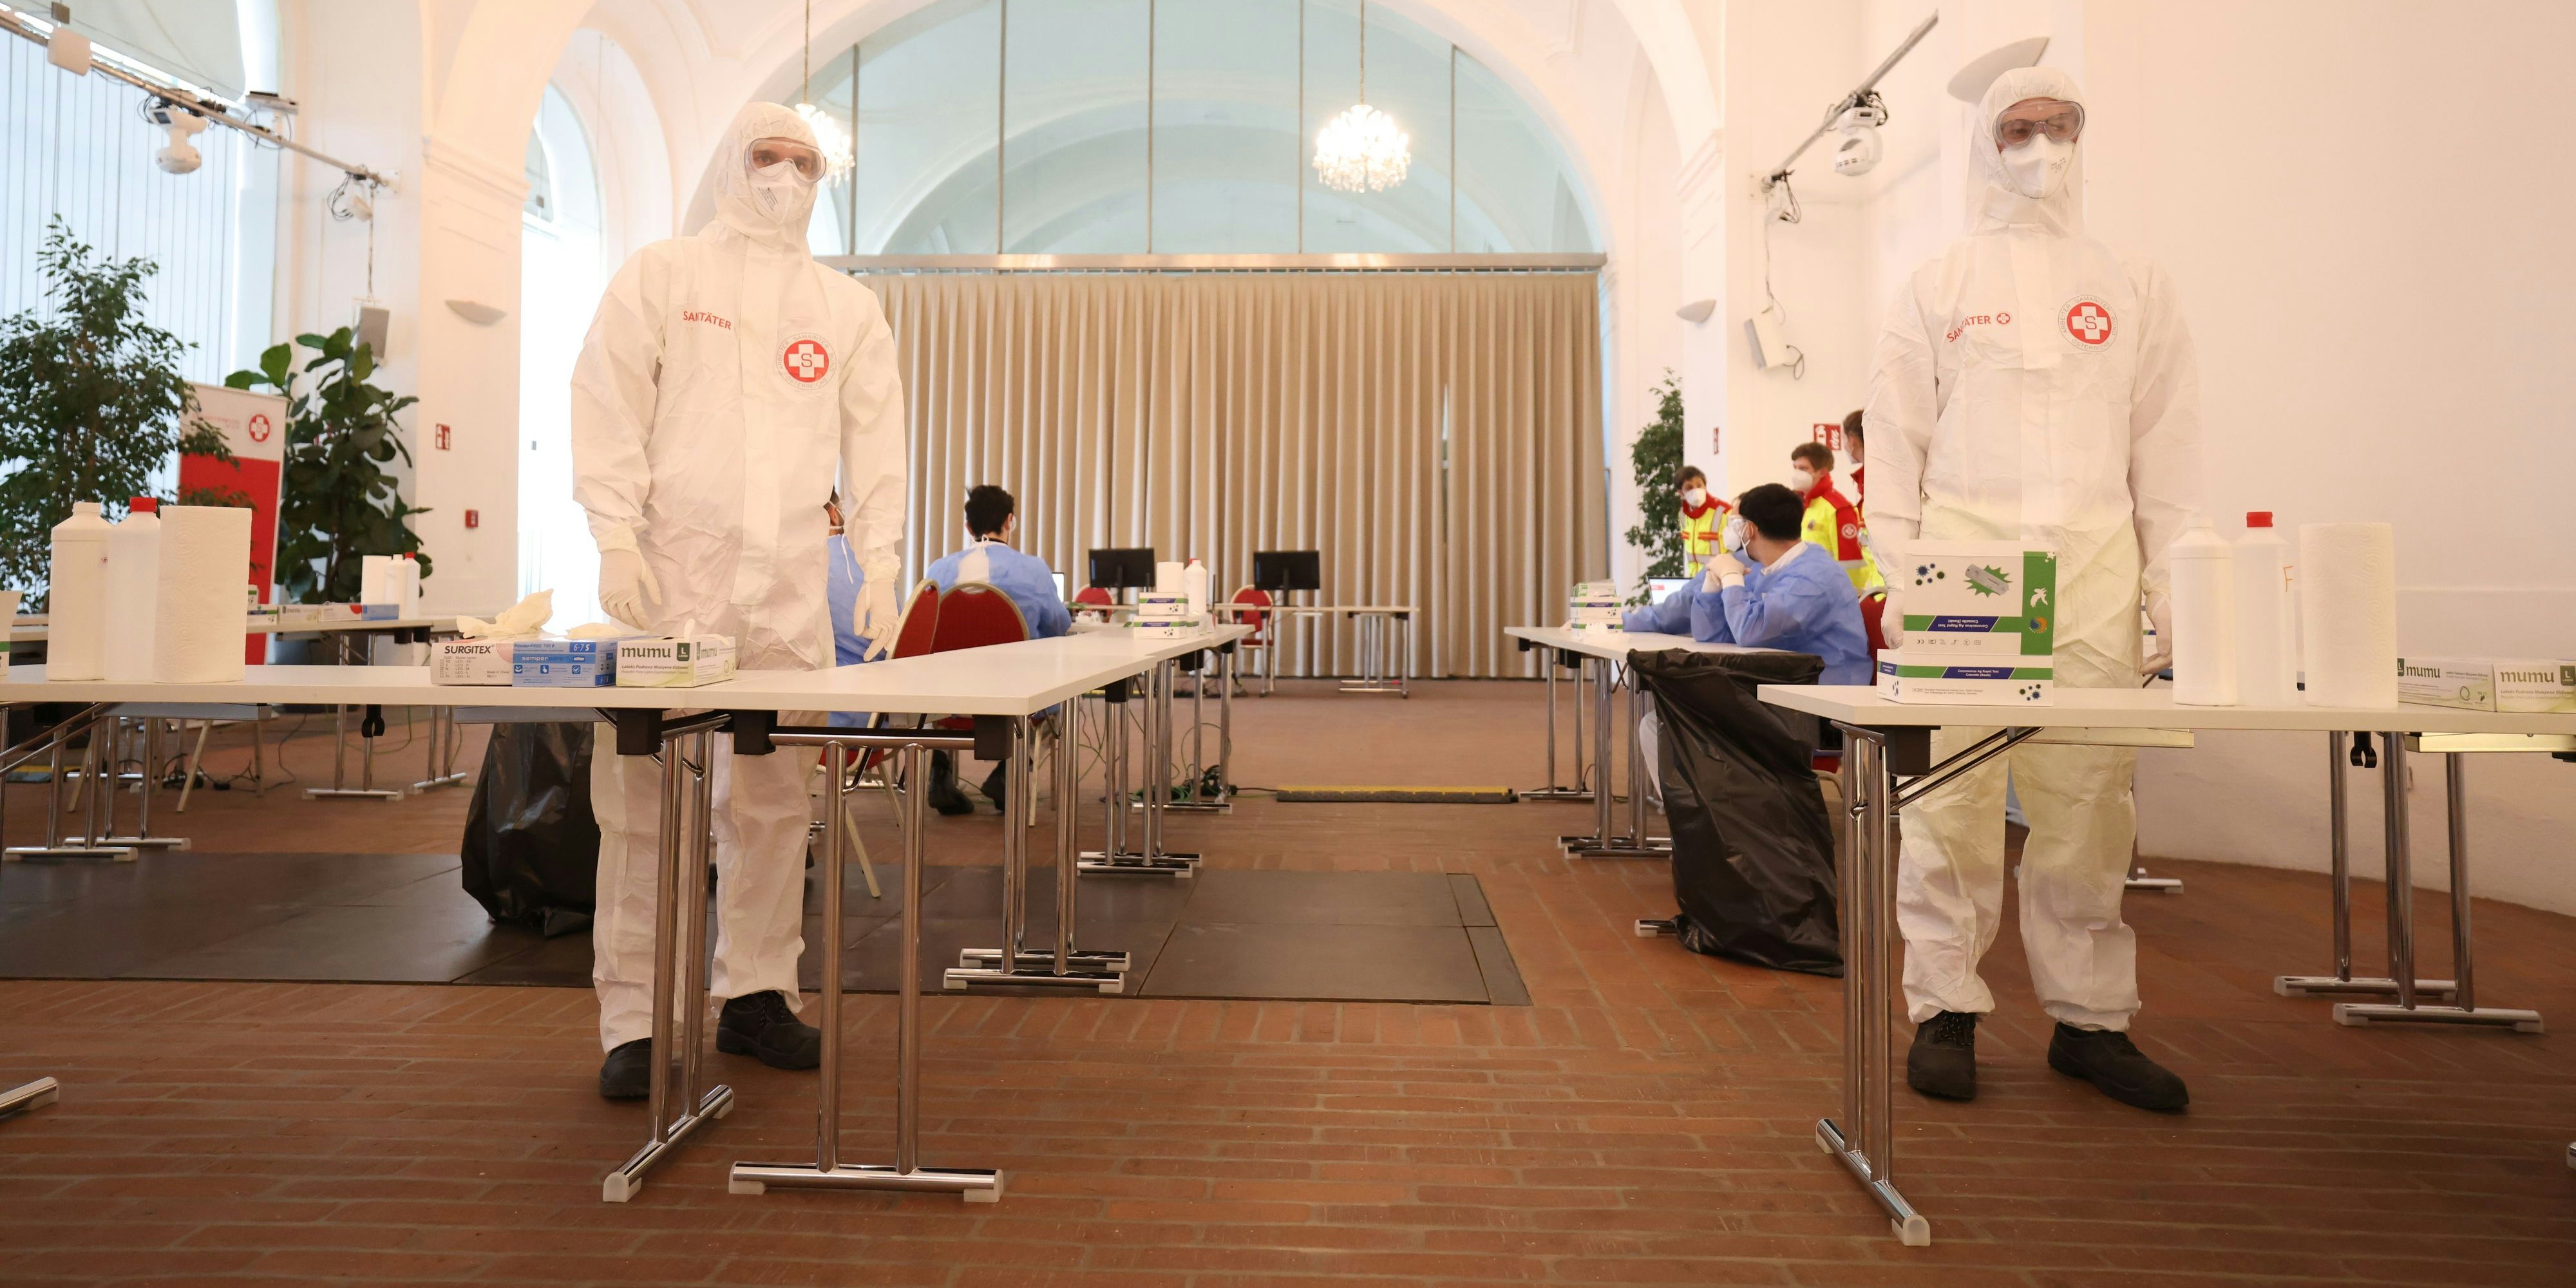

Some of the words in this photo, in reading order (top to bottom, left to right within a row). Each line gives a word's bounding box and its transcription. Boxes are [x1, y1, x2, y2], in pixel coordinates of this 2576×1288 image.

[683, 310, 732, 330] SANTÄTER
[2085, 316, 2097, 330] S
[1947, 316, 1991, 343] SANTÄTER
[801, 353, 813, 368] S
[444, 645, 491, 654] SURGITEX
[621, 647, 671, 658] mumu
[2407, 666, 2440, 678] mumu
[2500, 672, 2554, 683] mumu
